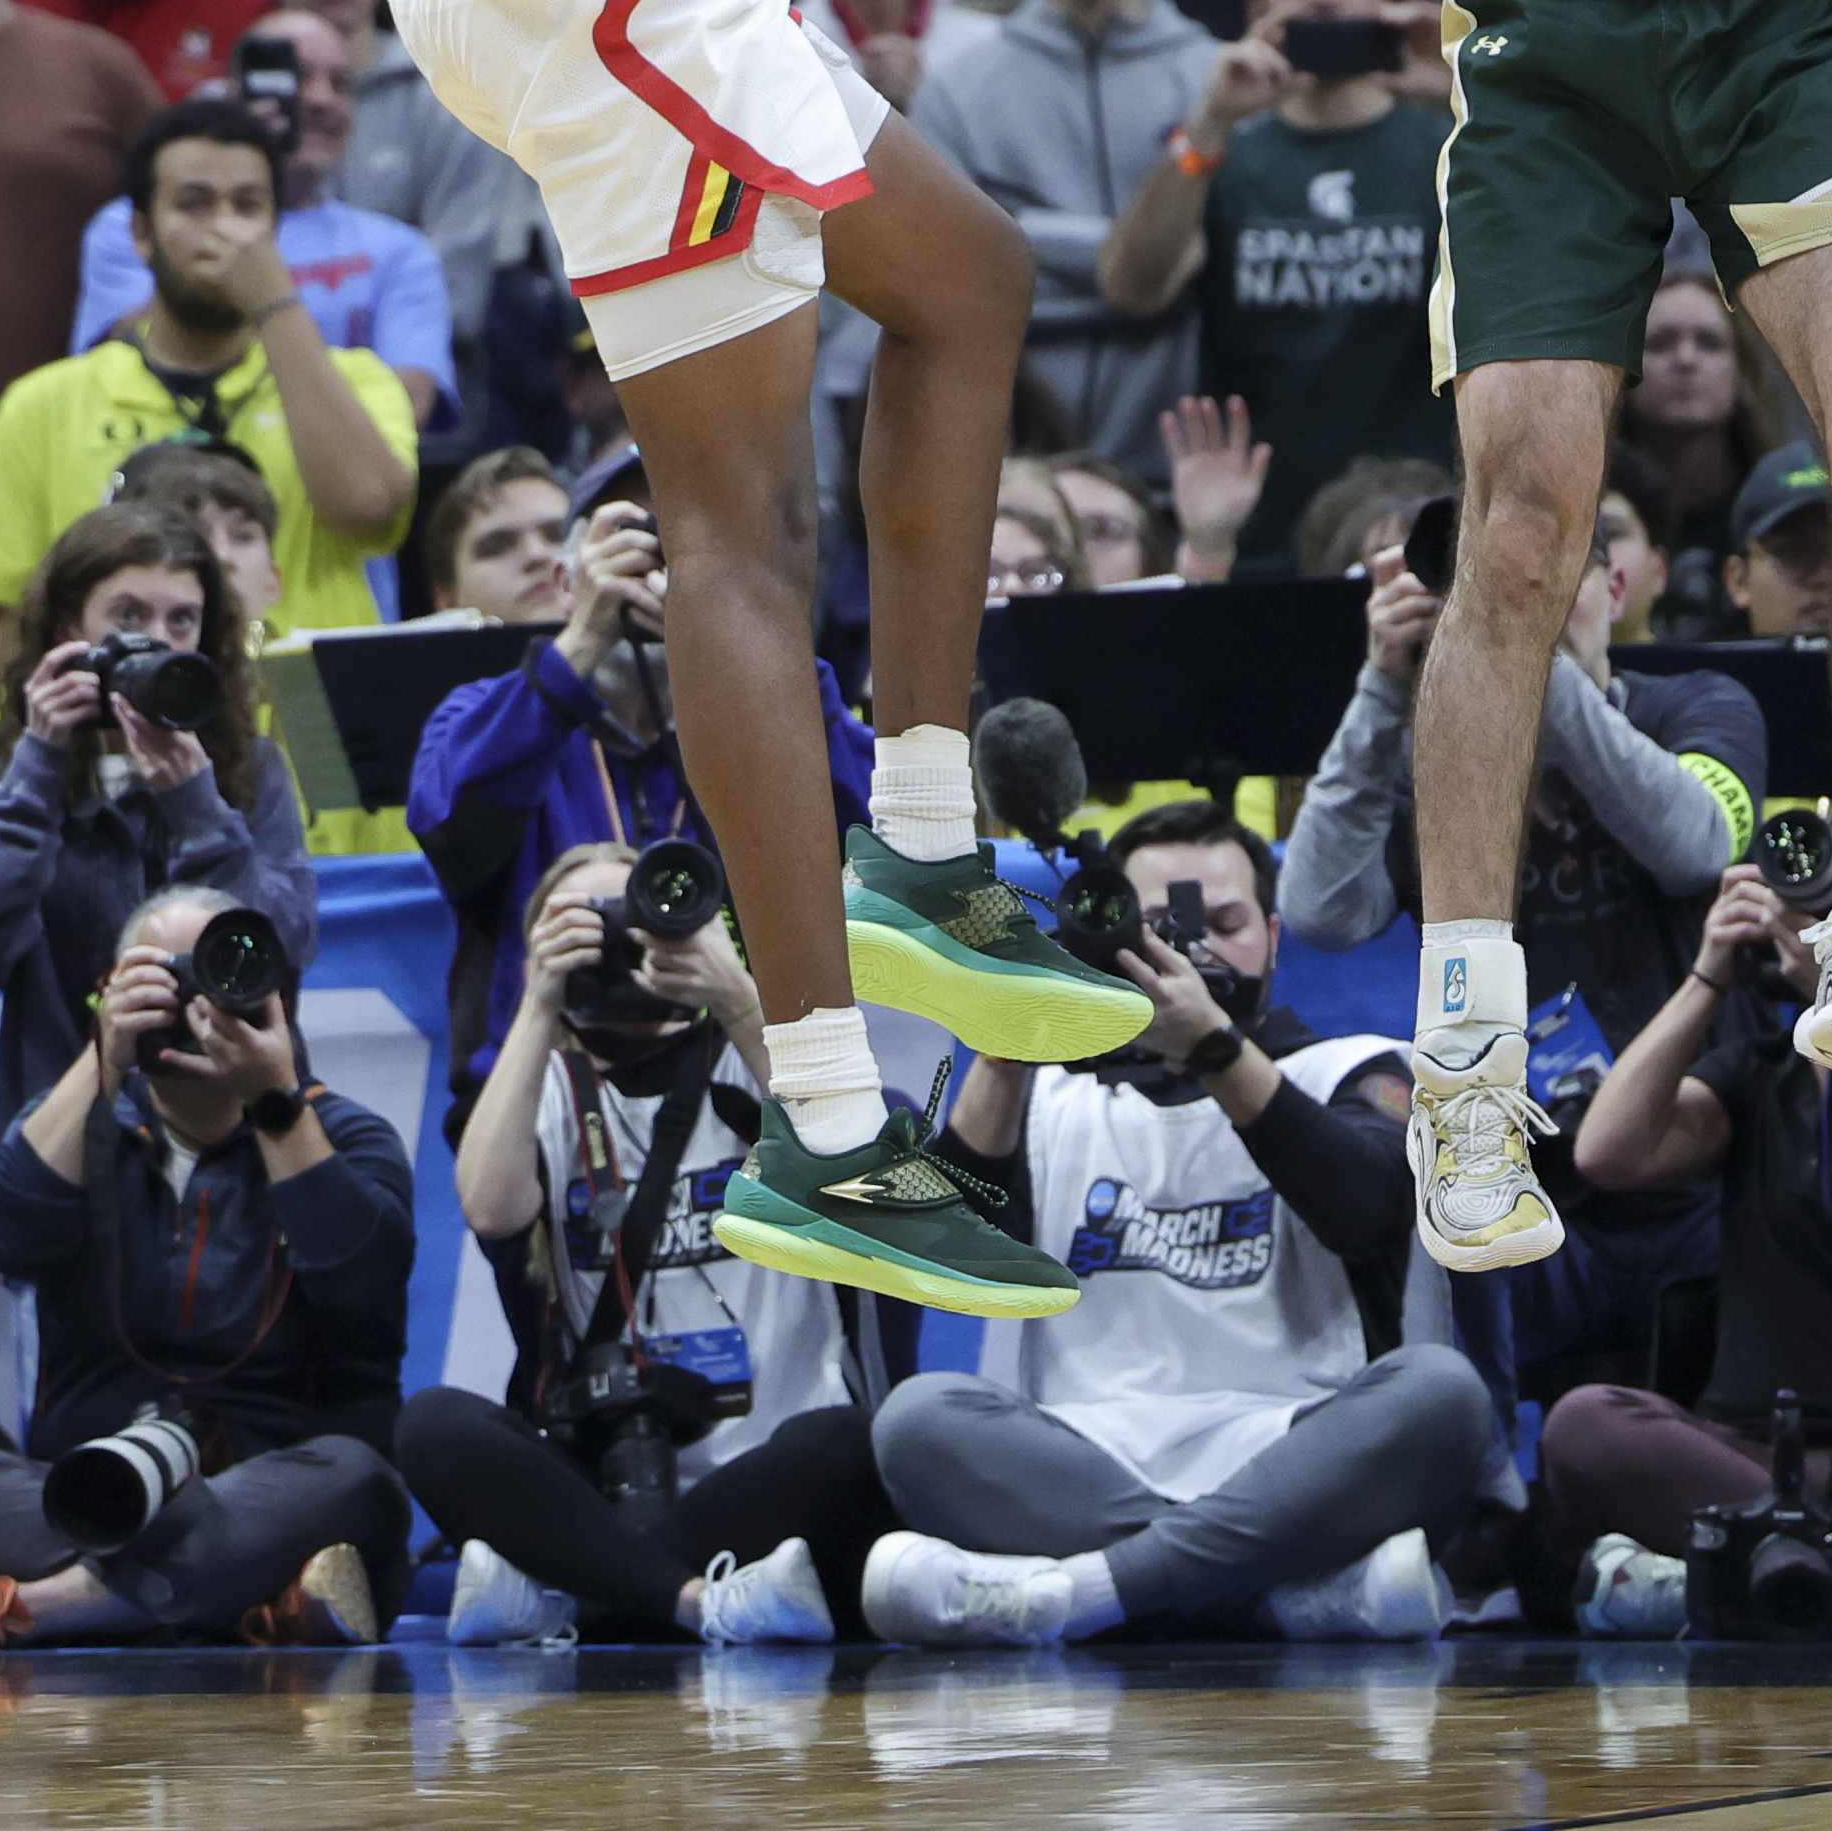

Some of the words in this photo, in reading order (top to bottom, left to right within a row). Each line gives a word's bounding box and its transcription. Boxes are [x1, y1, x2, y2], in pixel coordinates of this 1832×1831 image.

[1235, 252, 1426, 304] NATION
[1114, 1186, 1223, 1248] MARCH
[1122, 1220, 1271, 1280] MADNESS
